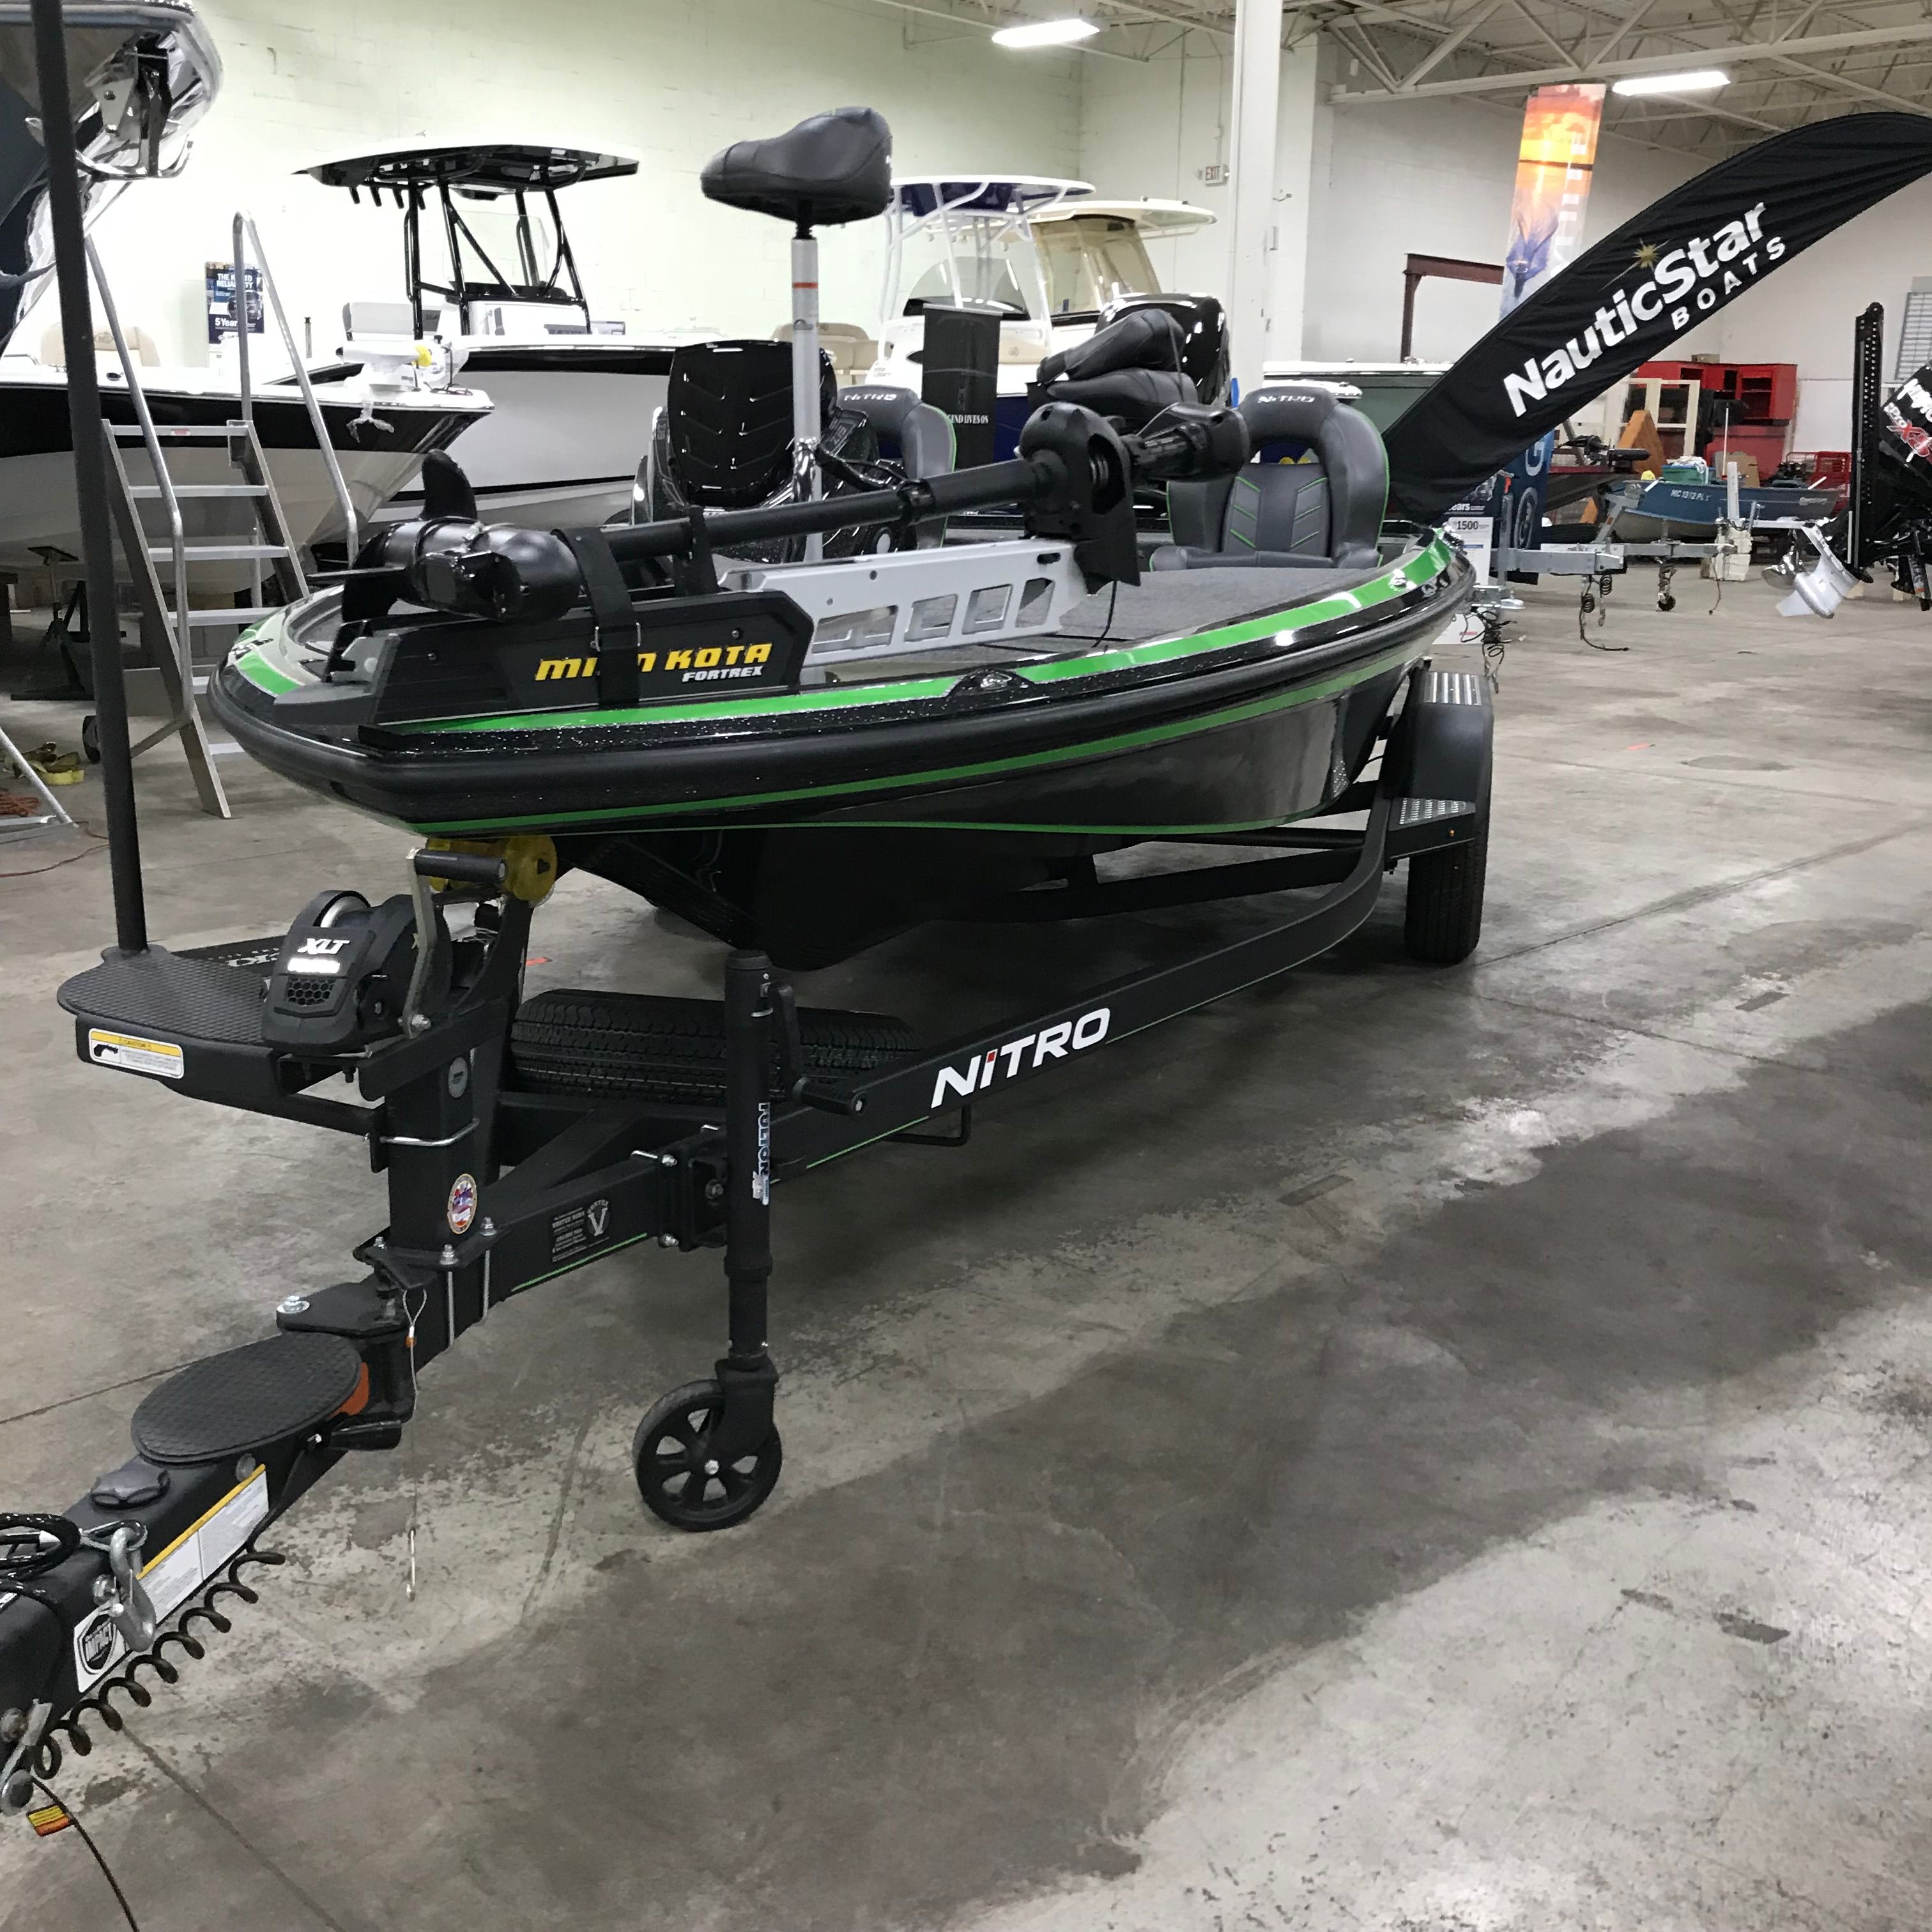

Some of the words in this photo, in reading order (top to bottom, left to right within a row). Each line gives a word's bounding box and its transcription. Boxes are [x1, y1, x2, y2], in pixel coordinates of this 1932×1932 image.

[1670, 236, 1786, 330] BOATS
[1503, 201, 1767, 417] NauticStar
[215, 318, 221, 326] 5
[221, 318, 238, 327] Year
[981, 415, 989, 424] ON
[1457, 521, 1479, 530] 1500
[534, 650, 657, 682] MIN
[664, 641, 773, 671] KOTA
[681, 666, 763, 683] FORTREX
[297, 938, 351, 955] XLT
[758, 1102, 770, 1176] FULTON
